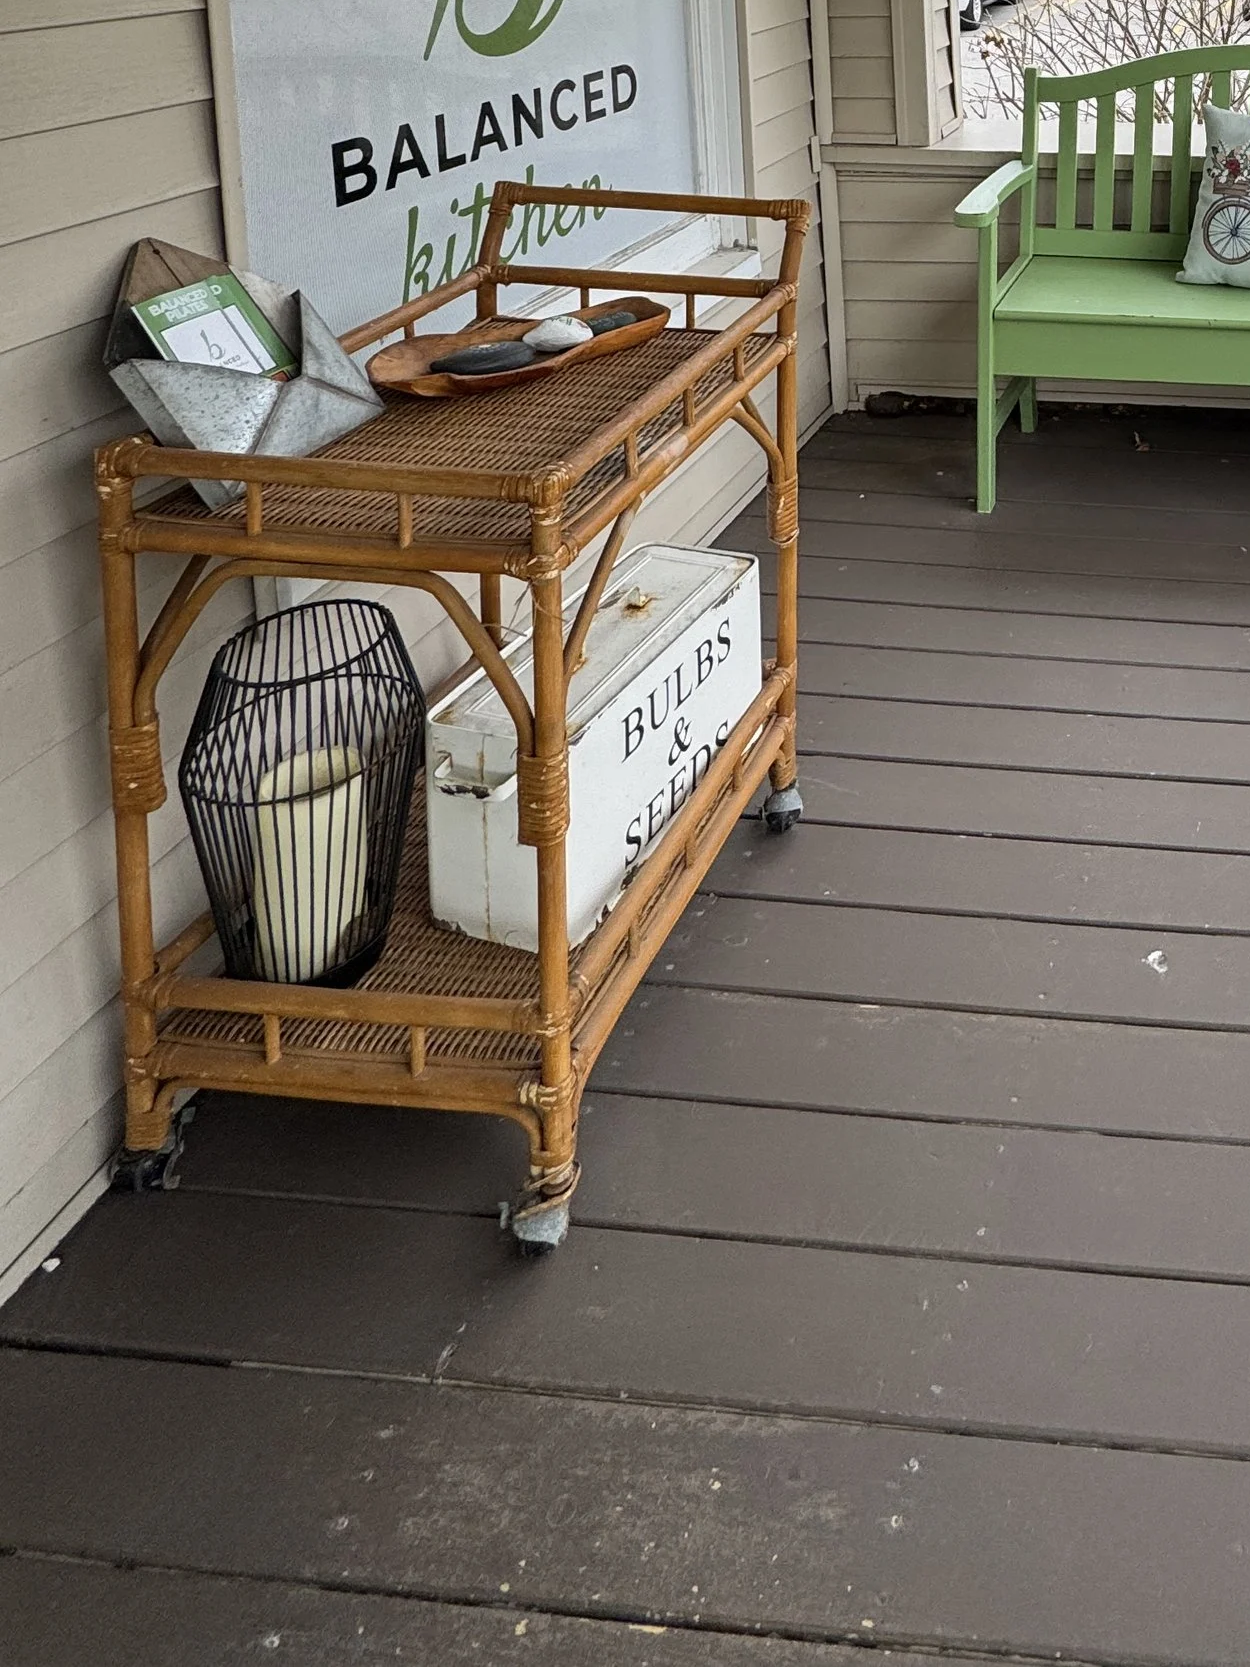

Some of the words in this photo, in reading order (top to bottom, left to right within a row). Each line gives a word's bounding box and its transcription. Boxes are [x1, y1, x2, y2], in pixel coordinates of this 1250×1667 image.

[331, 63, 638, 208] BALANCED
[148, 288, 209, 317] BALANCED
[165, 299, 209, 323] PILATES
[621, 617, 731, 764] BULBS
[668, 716, 692, 766] &
